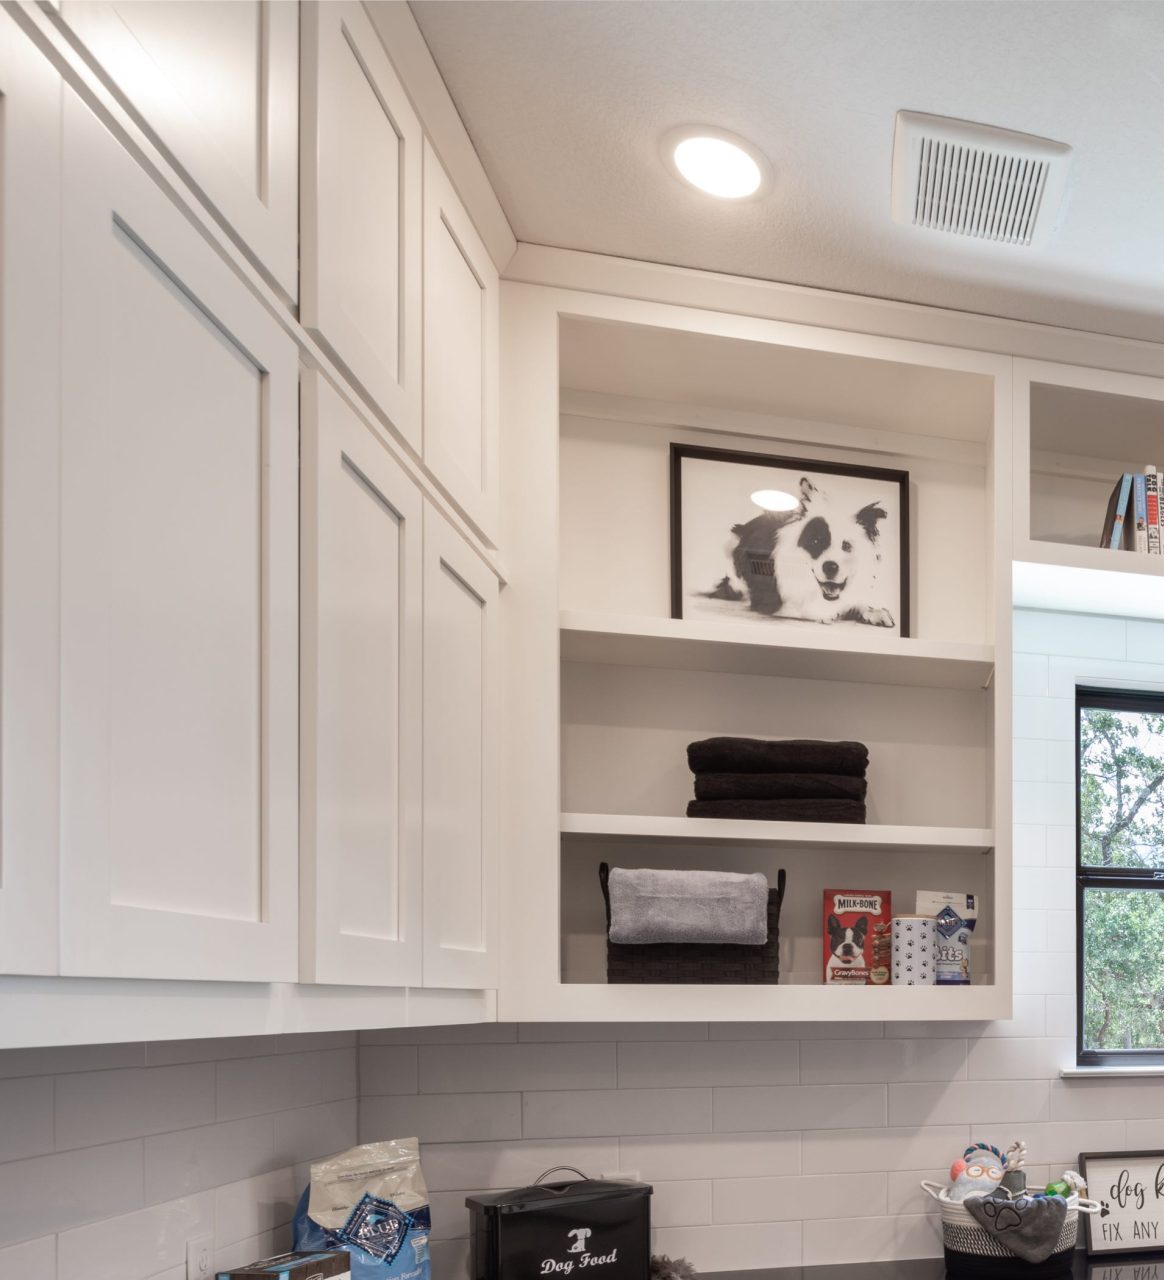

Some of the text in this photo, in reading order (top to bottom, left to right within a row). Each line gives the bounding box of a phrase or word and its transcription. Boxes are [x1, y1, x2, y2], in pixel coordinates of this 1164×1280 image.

[838, 898, 878, 910] MILK-BONE
[1110, 1169, 1147, 1210] dog
[1102, 1221, 1123, 1242] FIX
[1133, 1220, 1159, 1240] ANY
[540, 1248, 618, 1275] Dog Food
